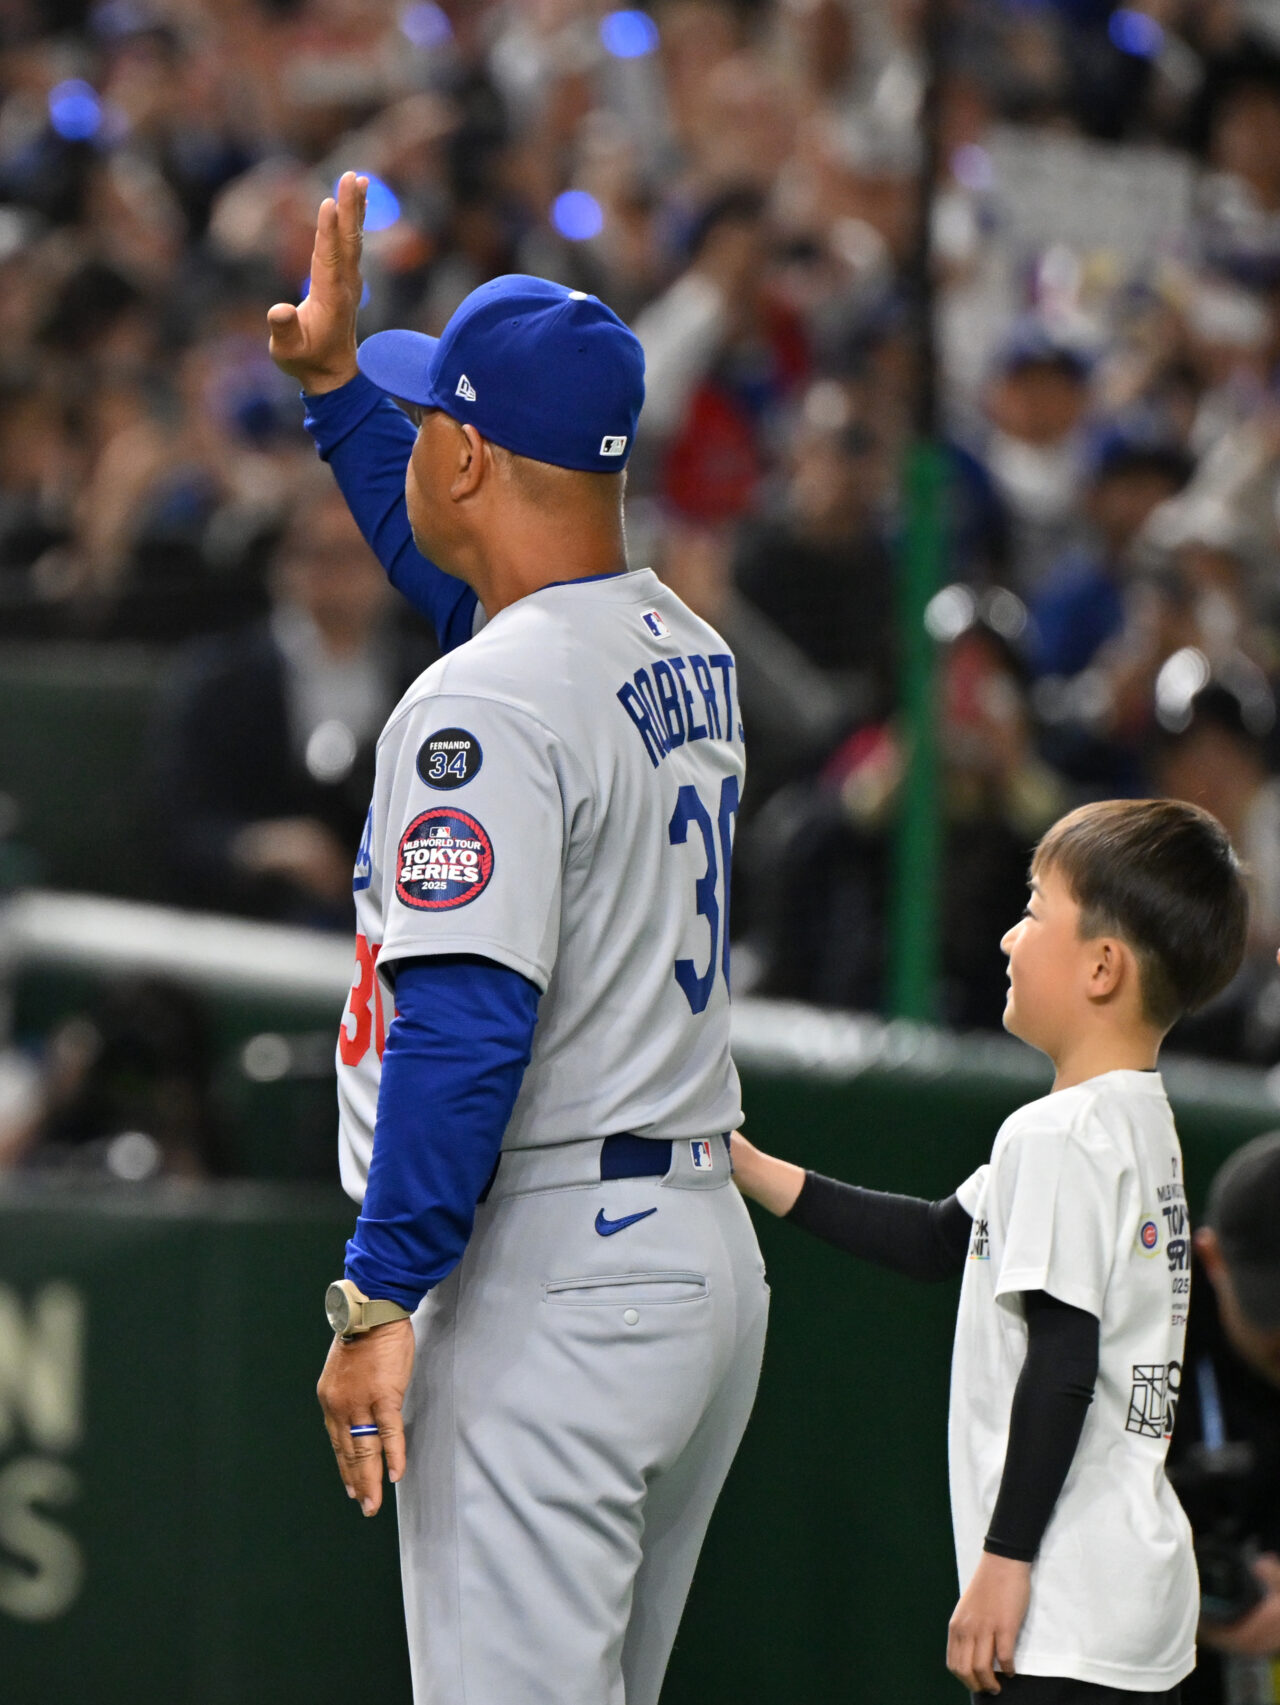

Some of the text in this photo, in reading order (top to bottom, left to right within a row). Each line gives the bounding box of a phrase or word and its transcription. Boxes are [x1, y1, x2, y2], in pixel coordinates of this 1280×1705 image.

[616, 654, 746, 769] ROBERT
[430, 740, 471, 751] FERNANDO
[429, 751, 467, 779] 34
[403, 838, 481, 851] MLB WORLD TOUR
[404, 848, 478, 867] TOKYO
[400, 864, 479, 883] SERIES
[422, 881, 447, 890] 2025
